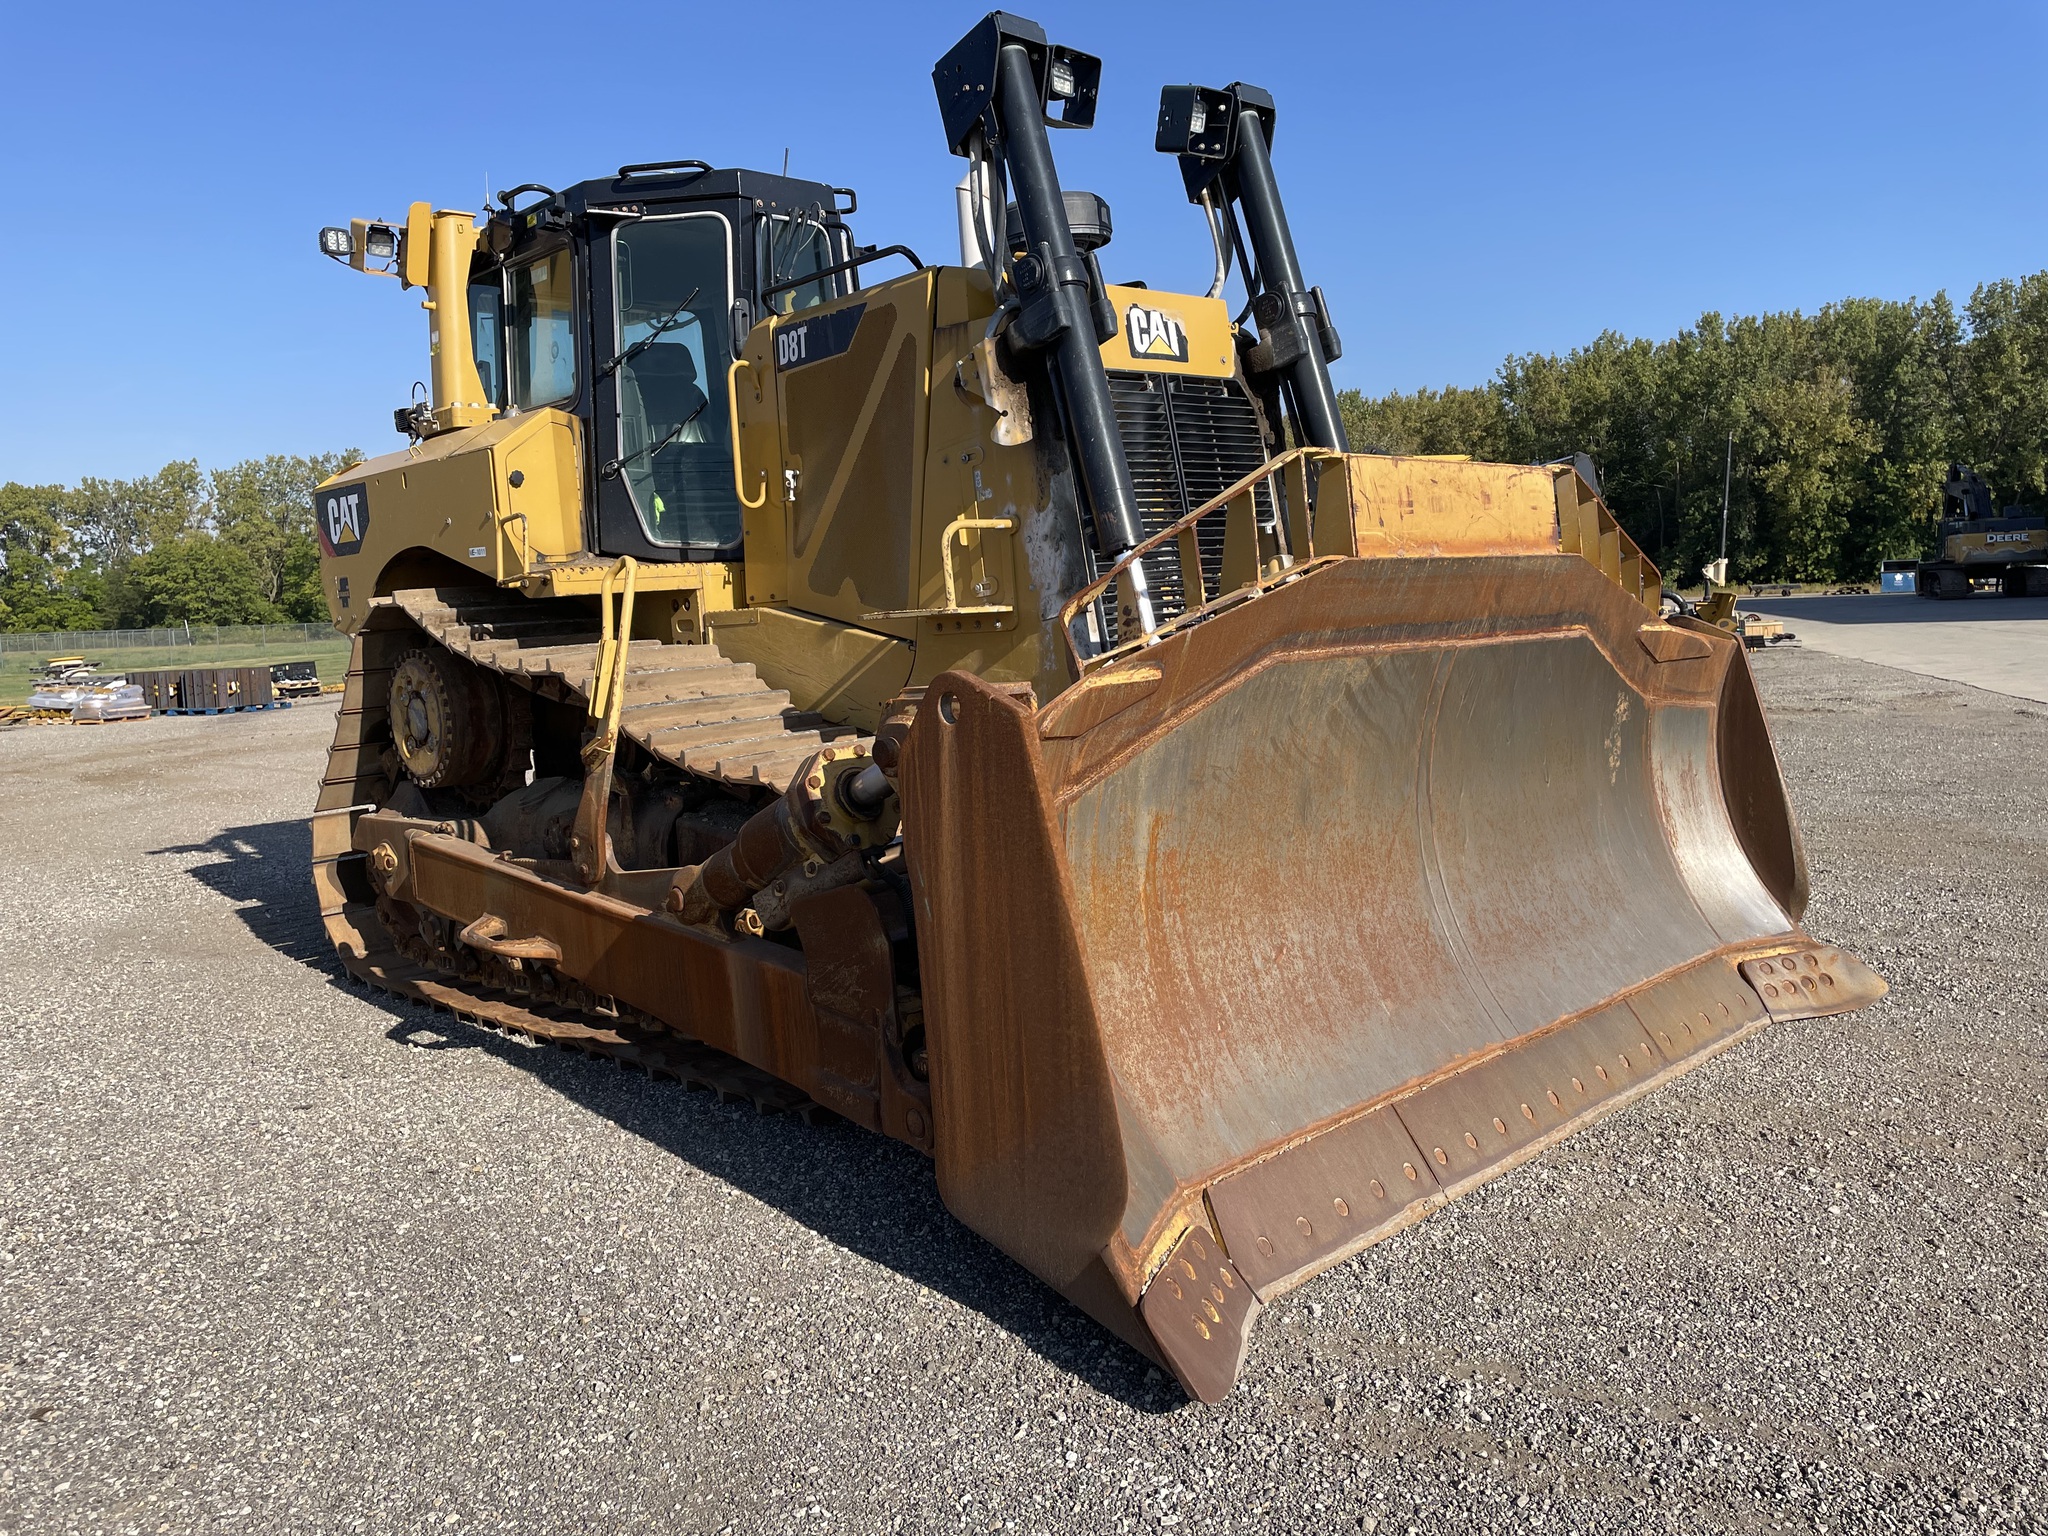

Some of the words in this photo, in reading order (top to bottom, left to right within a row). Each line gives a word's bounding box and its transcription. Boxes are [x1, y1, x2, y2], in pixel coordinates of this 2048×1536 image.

[778, 325, 808, 366] D8T
[1129, 307, 1180, 357] CAT
[327, 493, 361, 545] CAT
[1986, 533, 2030, 543] DEERE
